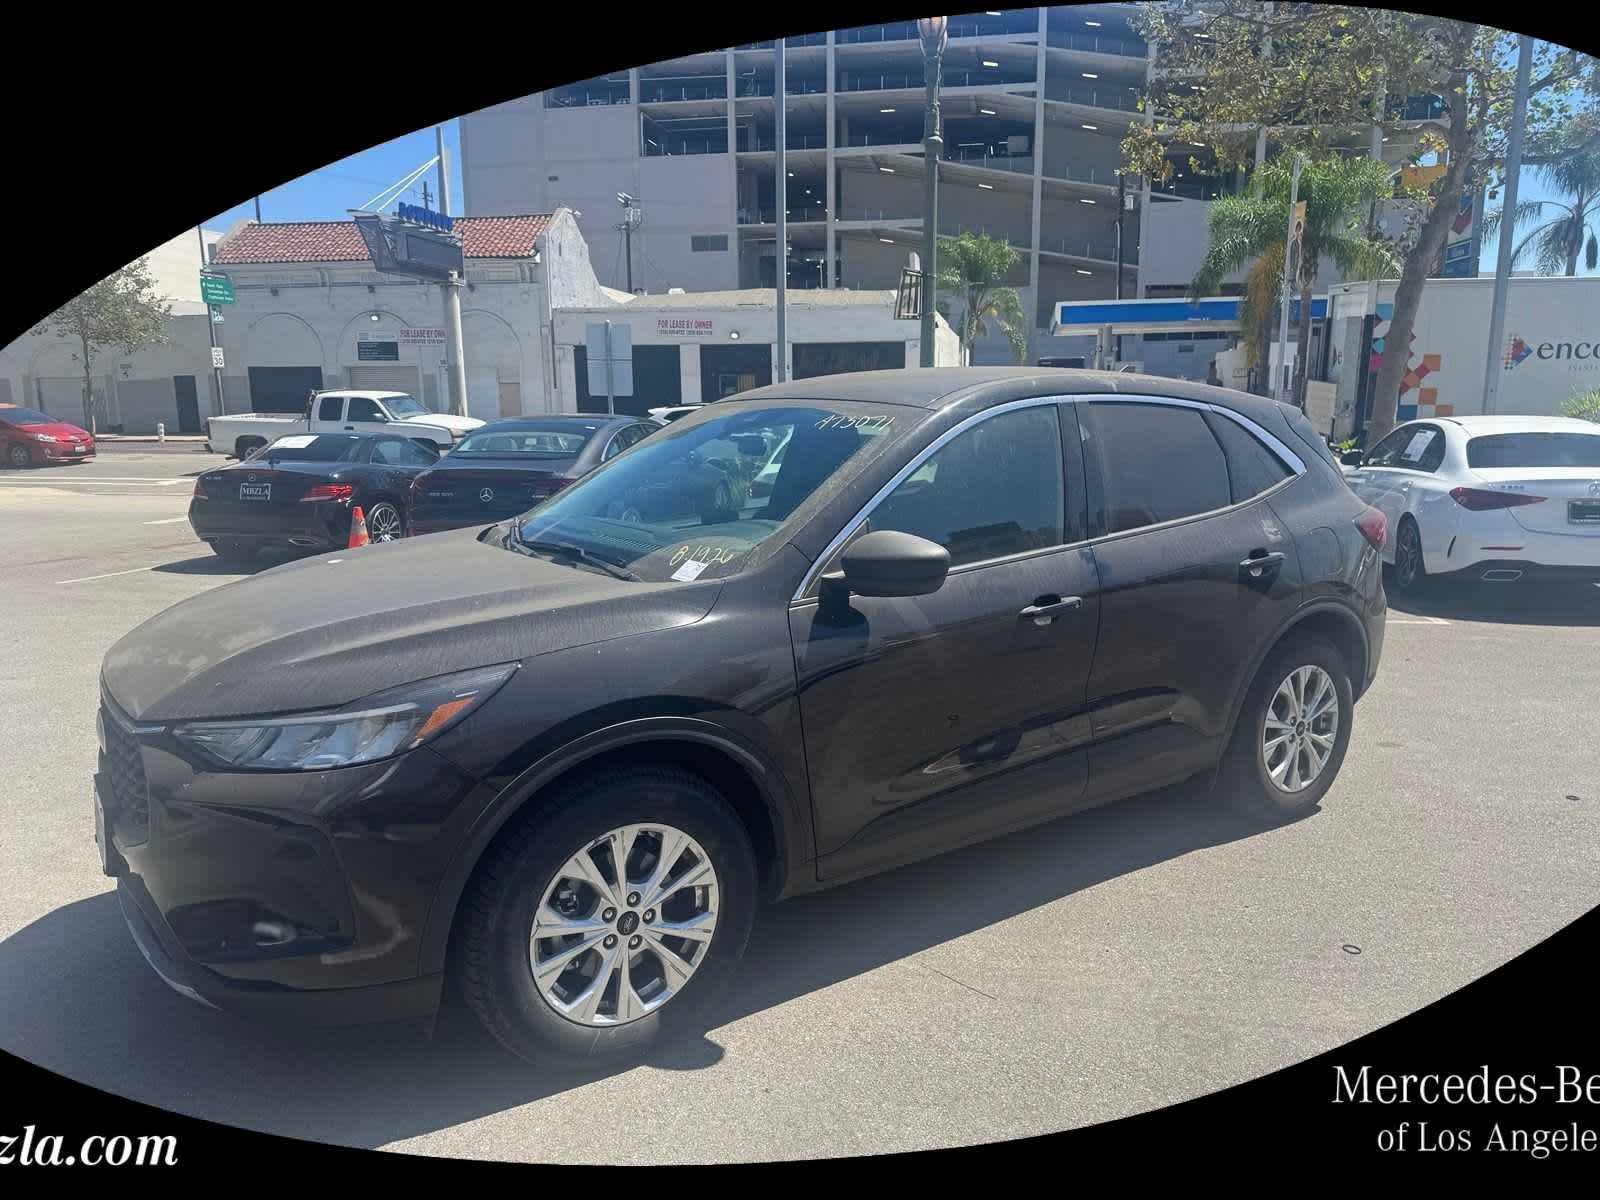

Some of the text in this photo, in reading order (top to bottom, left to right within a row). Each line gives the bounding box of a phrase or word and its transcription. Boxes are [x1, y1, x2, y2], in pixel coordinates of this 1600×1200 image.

[670, 320, 685, 328] LEASE
[695, 320, 712, 329] OWNER
[242, 487, 269, 495] MBZLA
